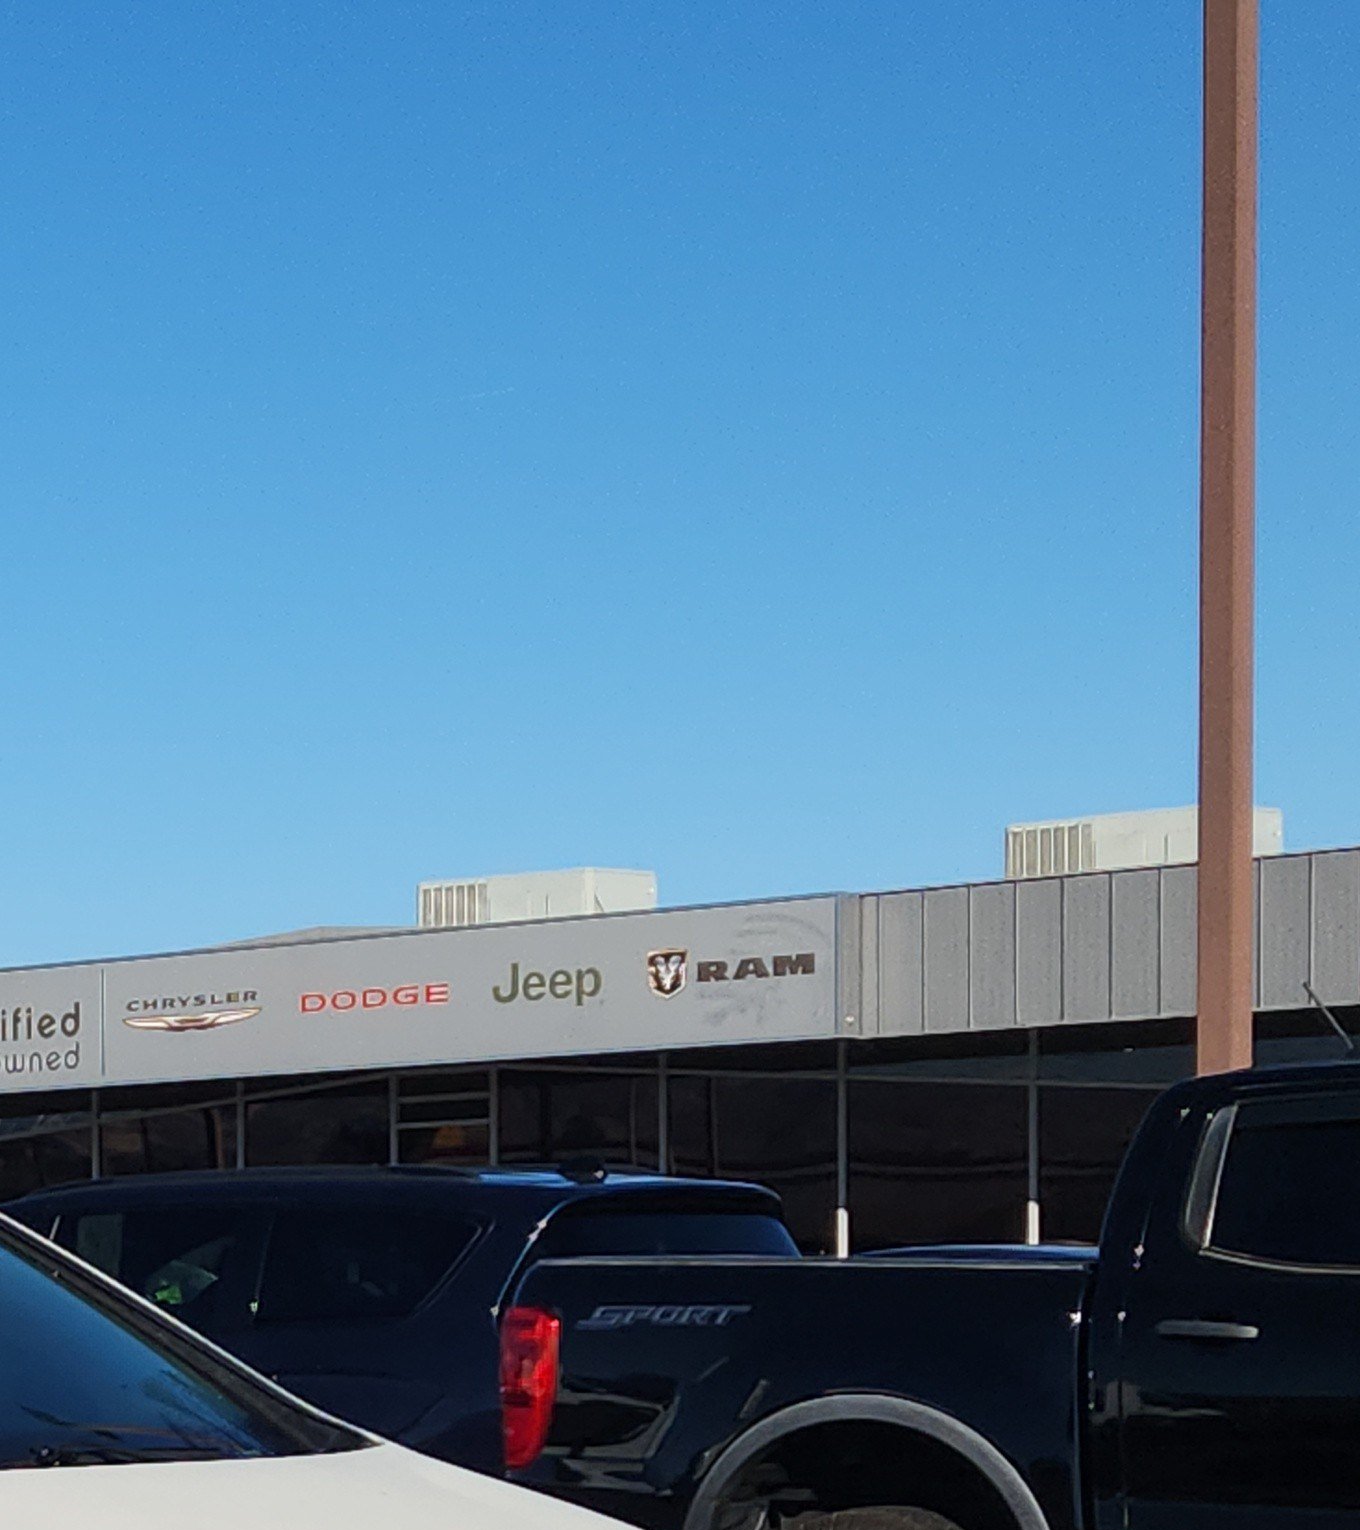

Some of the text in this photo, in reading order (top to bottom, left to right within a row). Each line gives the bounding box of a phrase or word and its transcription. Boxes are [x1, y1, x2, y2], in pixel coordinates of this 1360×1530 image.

[126, 953, 816, 1013] CHRYSLER DODGE Jeep RAM
[576, 1304, 753, 1331] SPORT
